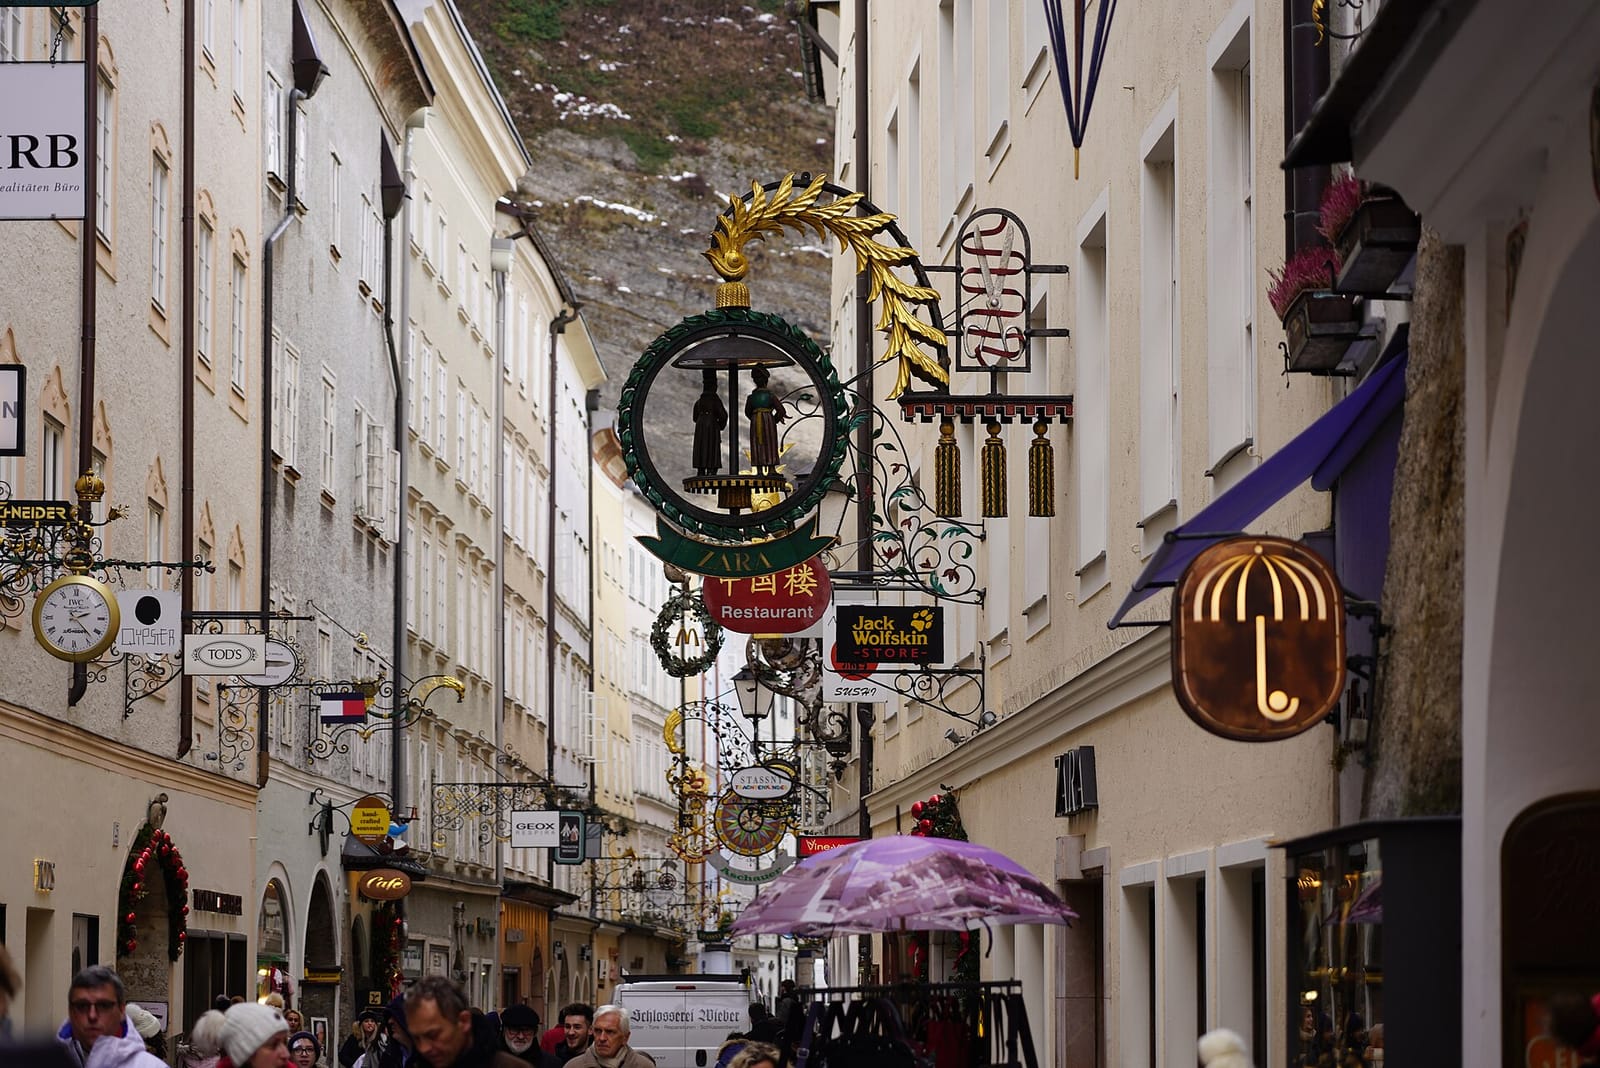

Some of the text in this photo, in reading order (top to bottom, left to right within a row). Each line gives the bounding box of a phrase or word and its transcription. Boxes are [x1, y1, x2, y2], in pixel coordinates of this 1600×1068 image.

[0, 134, 79, 169] RB
[54, 182, 80, 192] Büro
[698, 551, 773, 572] ZARA
[721, 604, 814, 619] Restaurant
[852, 615, 895, 631] Jack
[852, 630, 928, 646] Wolfskin
[207, 648, 242, 660] TOD'S
[834, 687, 877, 697] SUSHI
[516, 822, 556, 831] GEOX
[720, 866, 782, 882] Aschauer
[366, 876, 404, 890] Café
[631, 1008, 694, 1023] Schlosserei
